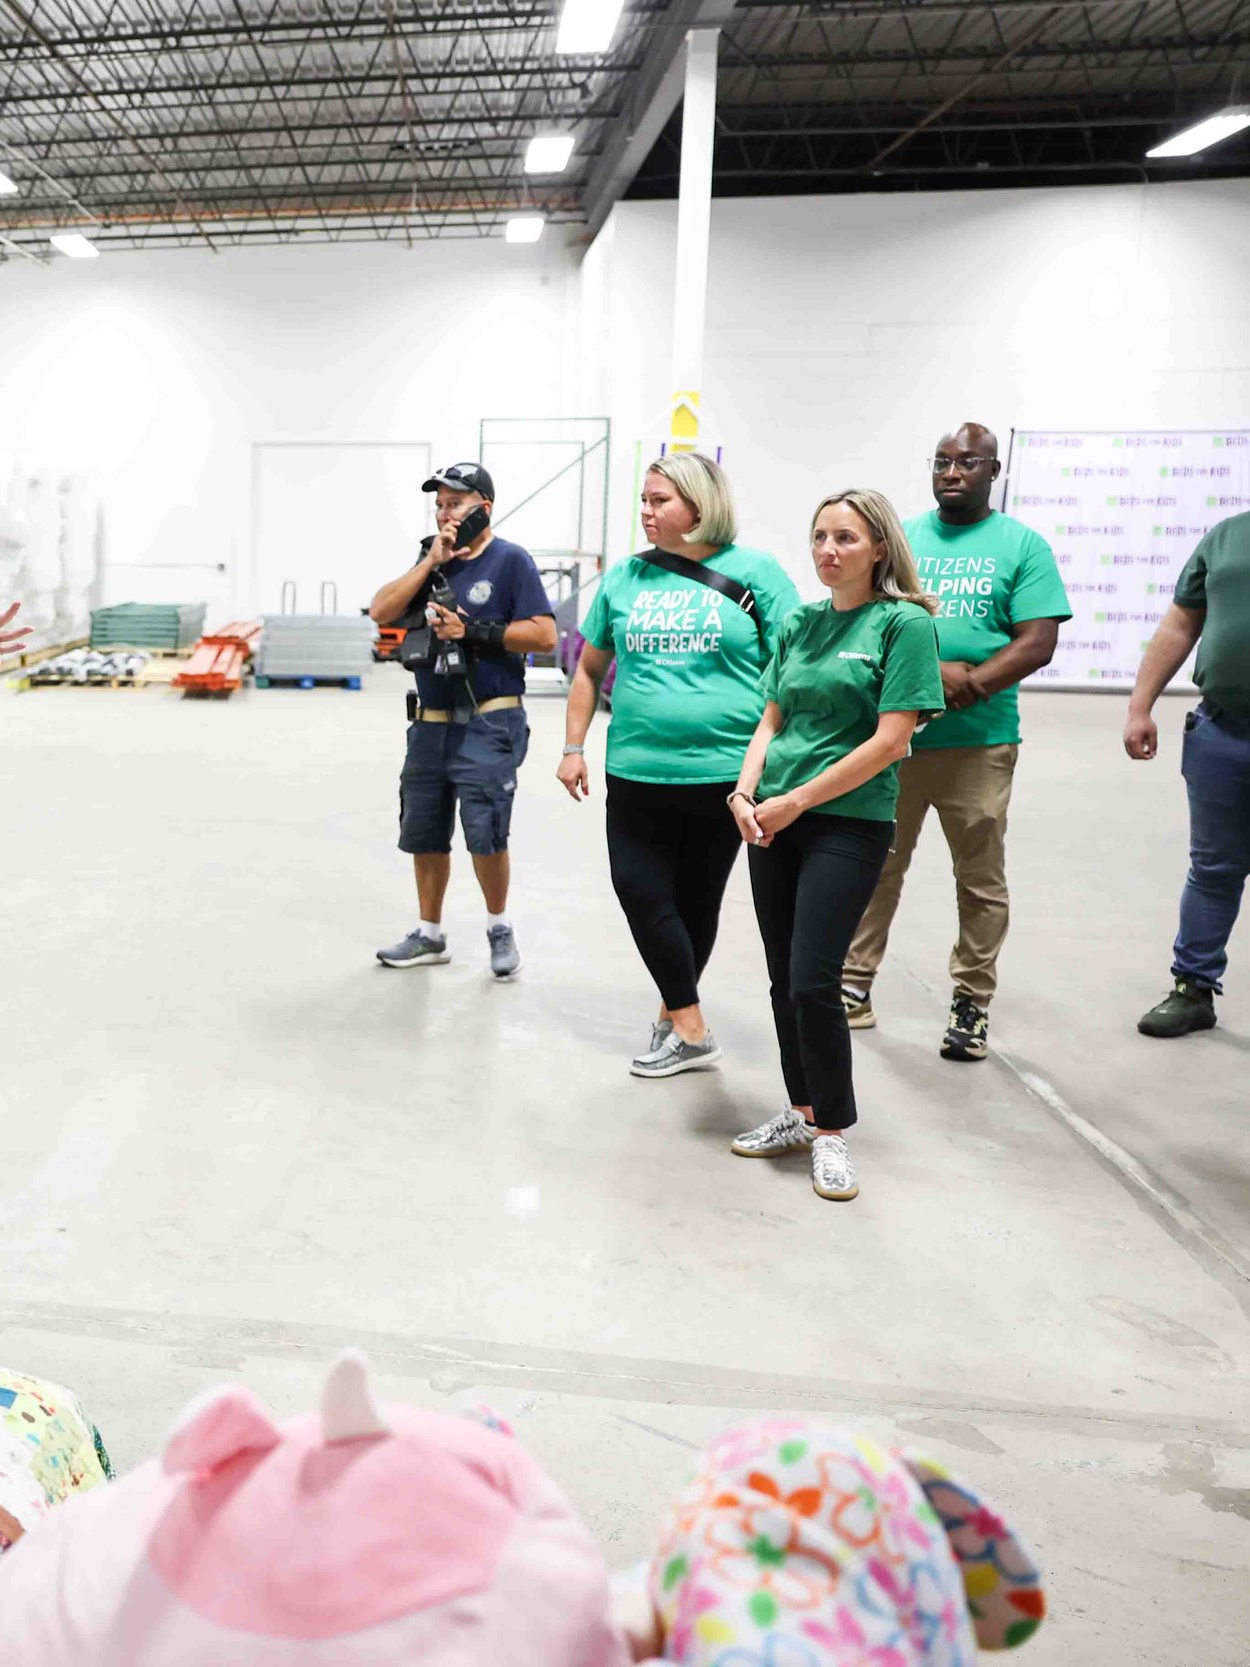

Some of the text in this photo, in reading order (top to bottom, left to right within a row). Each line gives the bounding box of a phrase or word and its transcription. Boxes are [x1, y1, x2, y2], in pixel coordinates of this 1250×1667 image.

[917, 556, 996, 575] ITIZENS
[919, 576, 992, 596] ELPING
[633, 589, 724, 609] READY TO
[935, 599, 988, 618] ZENS
[626, 607, 723, 631] MAKE A
[625, 632, 723, 653] DIFFERENCE
